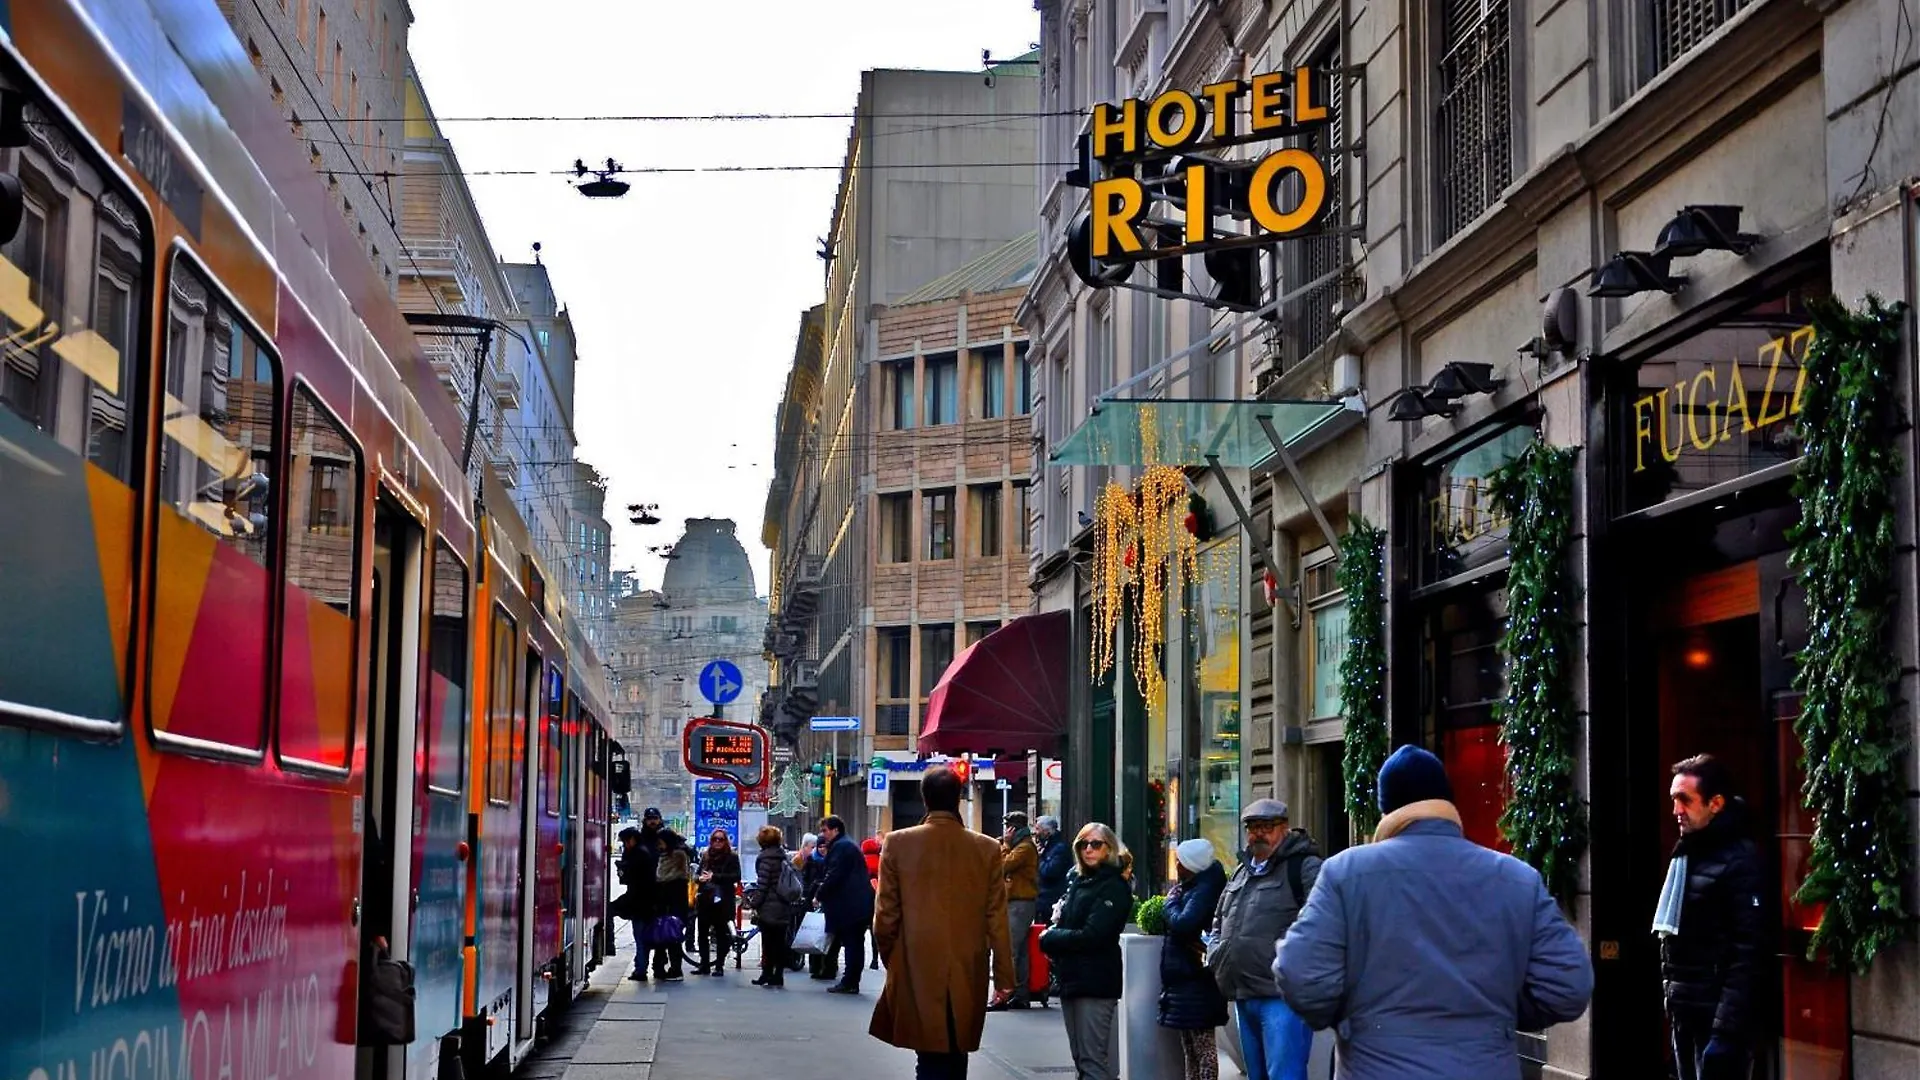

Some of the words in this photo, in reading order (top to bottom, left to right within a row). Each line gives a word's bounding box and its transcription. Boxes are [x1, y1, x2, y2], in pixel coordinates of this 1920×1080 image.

[1093, 66, 1329, 159] HOTEL
[1091, 148, 1327, 258] RIO
[698, 797, 737, 811] TRAM
[873, 775, 883, 788] P
[75, 889, 155, 1014] Vicino
[158, 889, 185, 989] ai
[186, 884, 228, 982] tuoi
[240, 972, 320, 1080] MILANO
